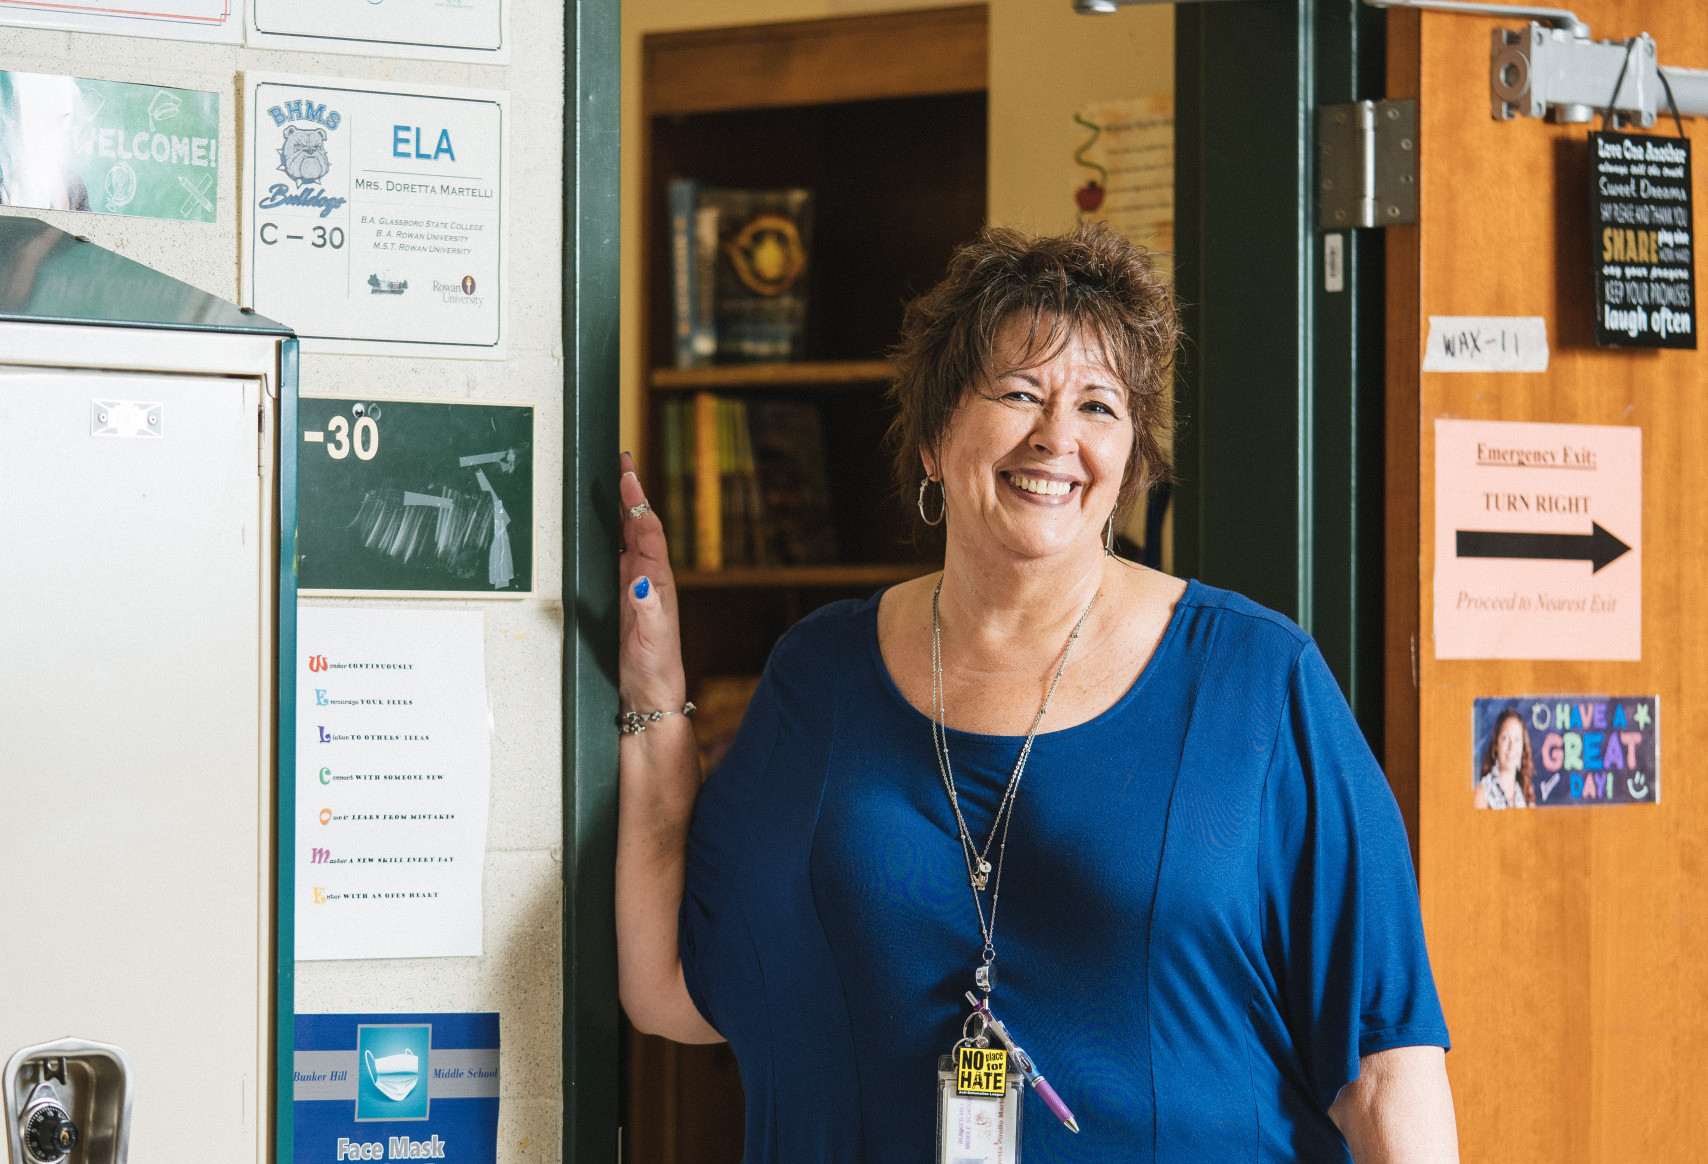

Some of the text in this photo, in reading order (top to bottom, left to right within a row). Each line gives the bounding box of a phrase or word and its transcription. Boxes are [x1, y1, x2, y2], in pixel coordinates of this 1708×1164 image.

[267, 99, 341, 131] BHMS
[392, 124, 456, 162] ELA
[258, 183, 347, 218] Bulldogs
[355, 178, 494, 199] MRS. DORETTA MARTELLI
[259, 222, 279, 246] C
[311, 225, 345, 250] 30
[395, 230, 425, 241] ROWAN
[426, 231, 470, 243] UNIVERSITY
[450, 221, 485, 232] COLLEGE
[398, 243, 428, 254] ROWAN
[428, 245, 474, 256] UNIVERSITY
[1602, 227, 1659, 263] SHARE
[432, 279, 462, 294] Rowan
[442, 292, 485, 309] University
[1604, 302, 1692, 340] laugh often
[303, 415, 379, 461] -30
[1476, 443, 1557, 467] Emergency
[1483, 491, 1592, 515] TURN RIGHT
[1455, 590, 1618, 615] Proceed to Nearest Exit
[1555, 703, 1628, 731] HAVE A
[1541, 731, 1643, 772] GREAT
[1568, 771, 1615, 800] DAY!
[961, 1050, 1004, 1070] NO place
[986, 1062, 1004, 1071] for
[293, 1070, 347, 1083] Bunker Hill
[432, 1066, 499, 1079] Middle School
[960, 1071, 1004, 1090] HATE
[336, 1133, 447, 1161] Face Mask
